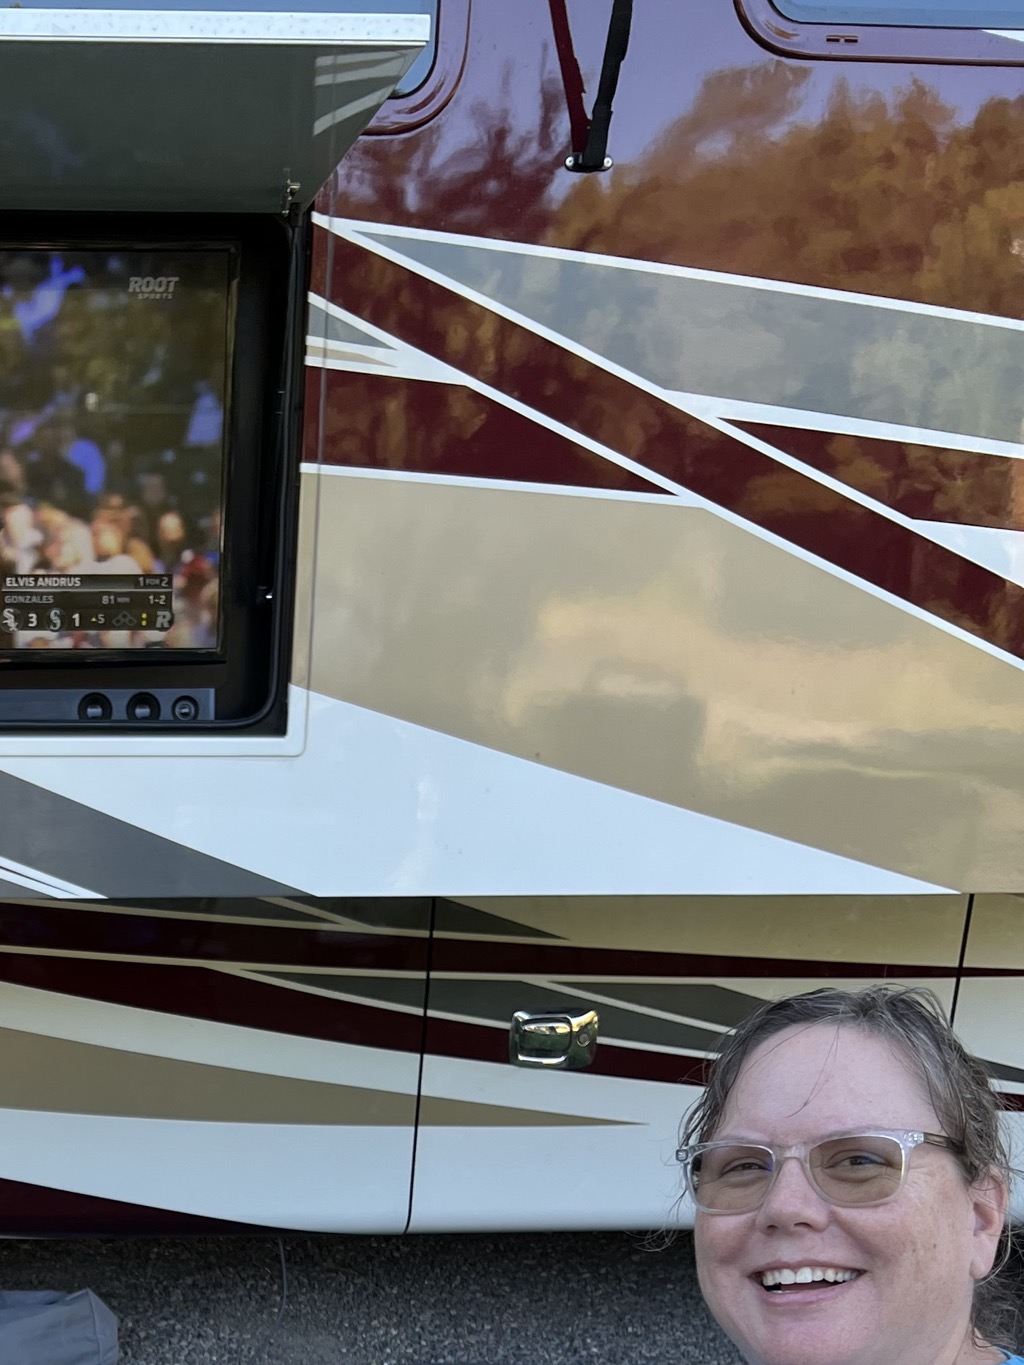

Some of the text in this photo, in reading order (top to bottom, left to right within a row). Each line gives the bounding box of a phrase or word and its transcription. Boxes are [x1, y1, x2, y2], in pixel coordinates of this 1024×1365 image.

[128, 276, 180, 293] ROOT
[6, 577, 36, 587] ELVIS
[37, 577, 81, 588] ANDRUS
[138, 578, 144, 587] 1
[161, 578, 168, 587] 2
[4, 595, 54, 604] GONZALES
[102, 595, 115, 604] 81
[28, 614, 38, 627] 3
[72, 614, 80, 627] 1
[97, 614, 105, 624] 5
